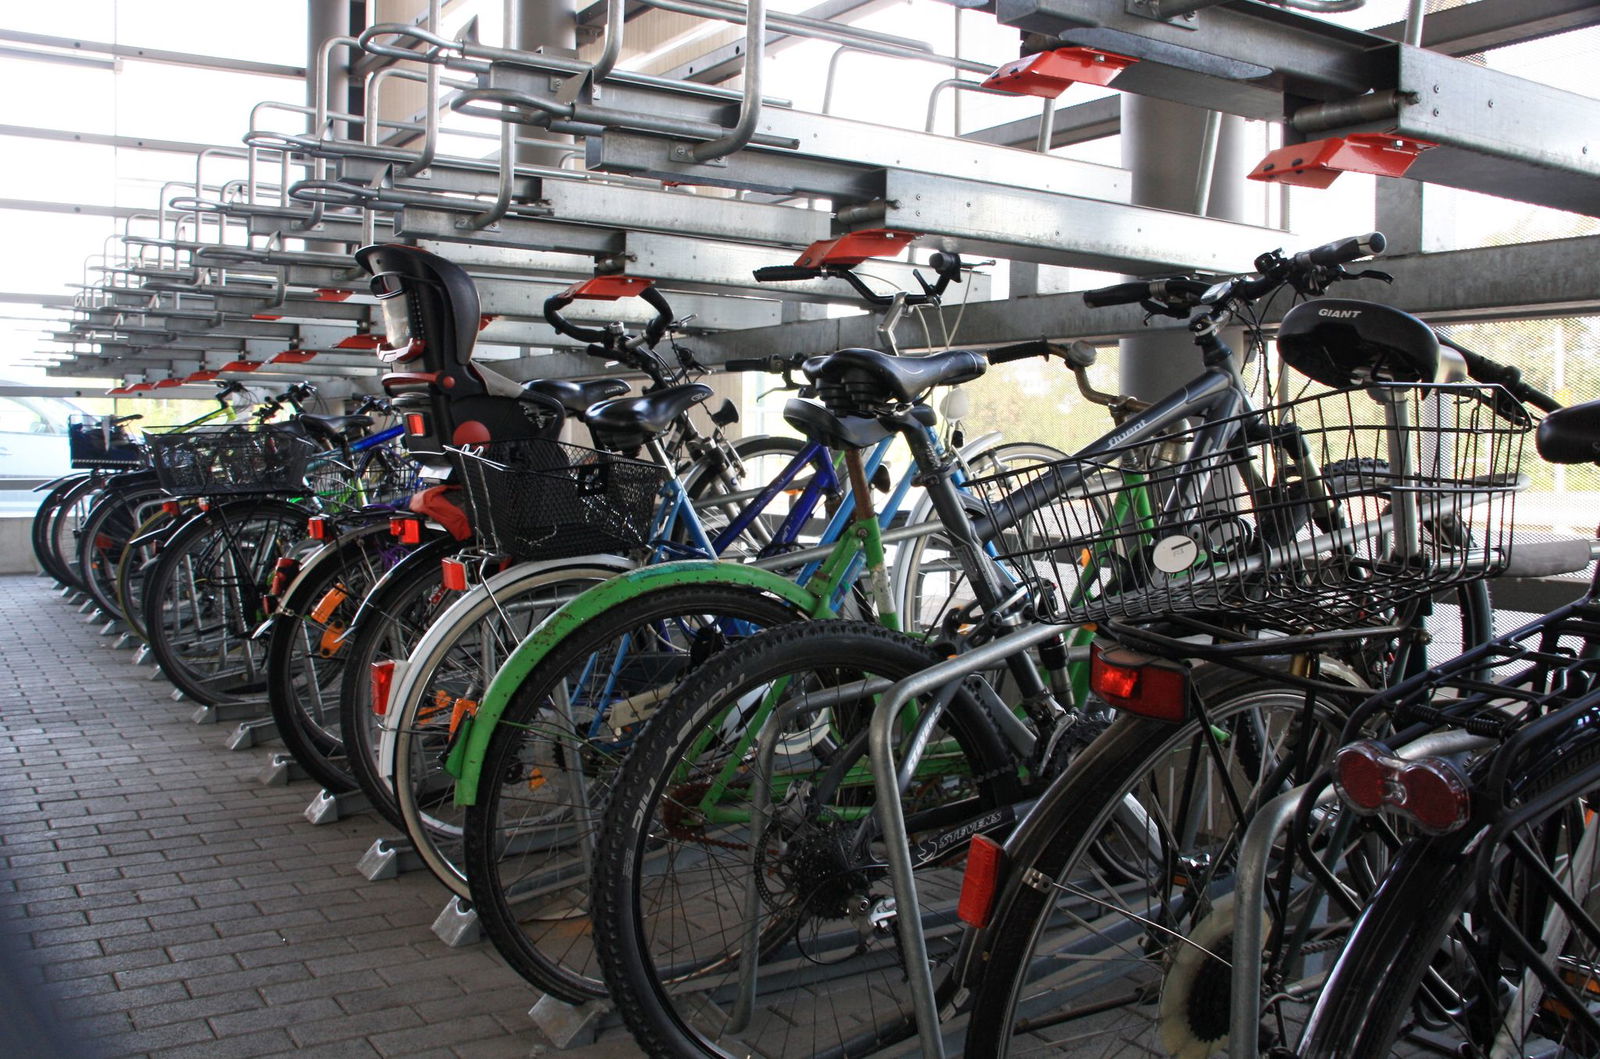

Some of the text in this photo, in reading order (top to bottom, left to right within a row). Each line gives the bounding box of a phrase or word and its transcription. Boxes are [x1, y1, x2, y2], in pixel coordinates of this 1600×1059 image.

[1318, 308, 1362, 319] GIANT
[907, 701, 942, 776] STEVENS
[939, 809, 1002, 849] STEVENS
